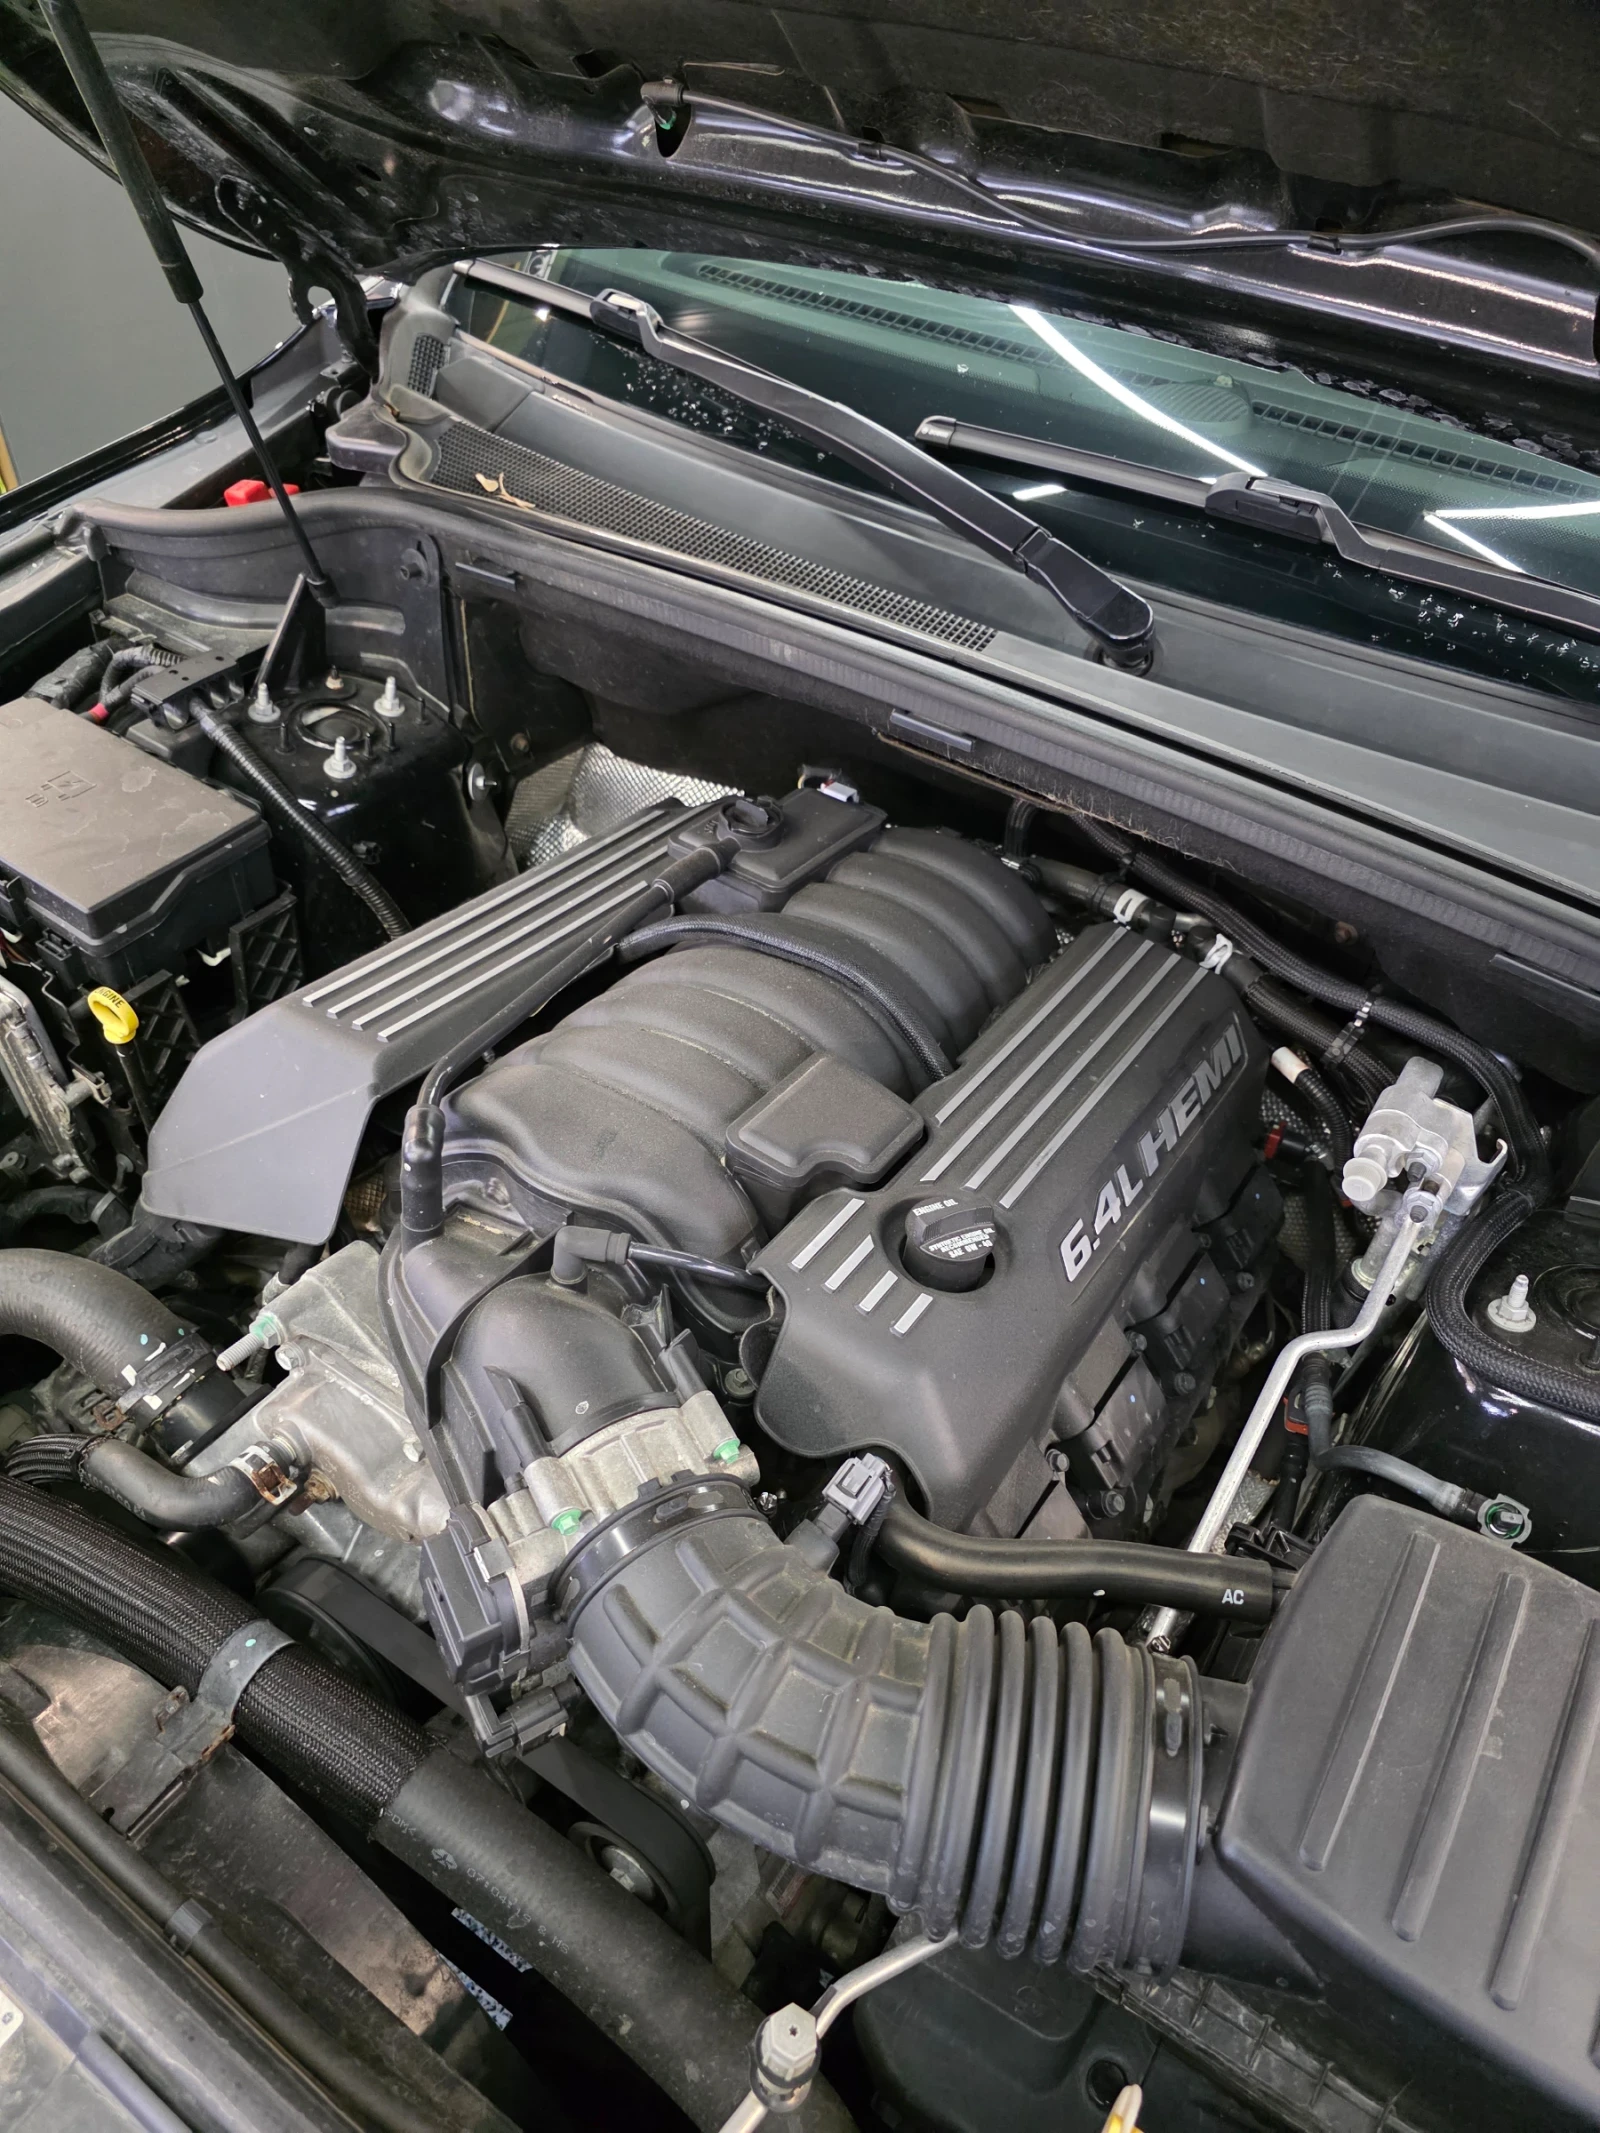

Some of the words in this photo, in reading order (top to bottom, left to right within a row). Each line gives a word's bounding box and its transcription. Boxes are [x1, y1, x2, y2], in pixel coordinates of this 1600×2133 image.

[1058, 1163, 1144, 1282] 6.4L
[1138, 1024, 1244, 1177] HEMI
[912, 1201, 945, 1216] ENGINE
[943, 1198, 959, 1207] OIL
[928, 1235, 961, 1252] SYNTHETIC
[960, 1229, 983, 1240] ENGINE
[939, 1234, 990, 1253] RECOMMENDED
[948, 1248, 965, 1258] SAE
[1221, 1588, 1245, 1605] AC
